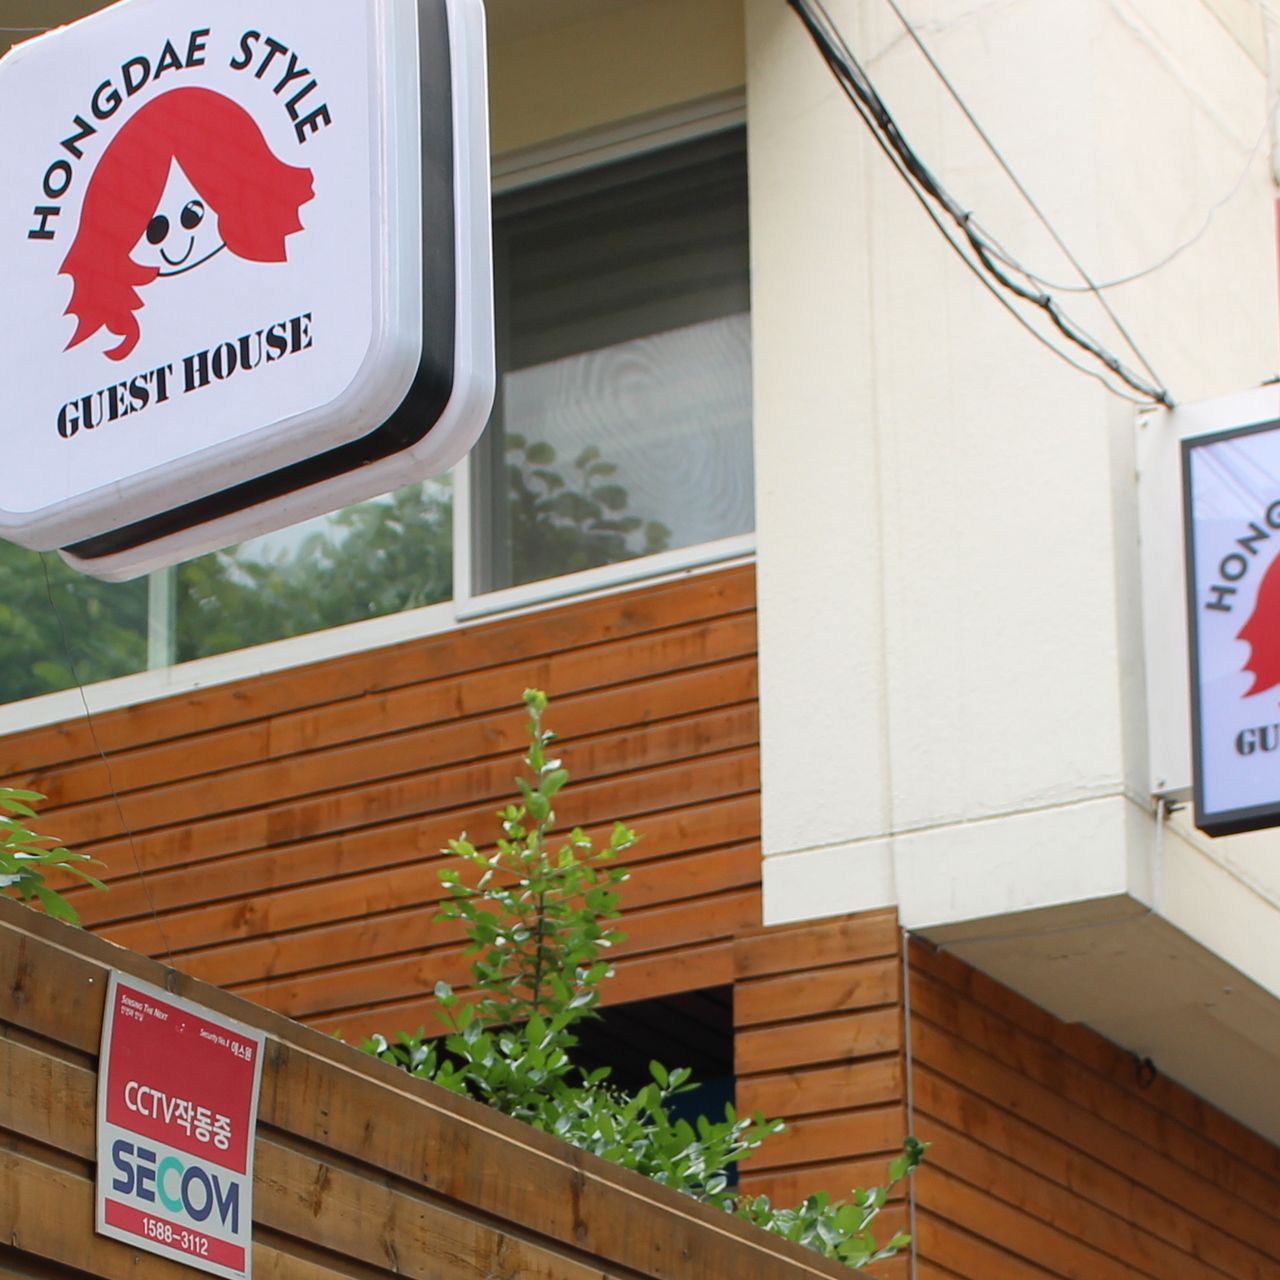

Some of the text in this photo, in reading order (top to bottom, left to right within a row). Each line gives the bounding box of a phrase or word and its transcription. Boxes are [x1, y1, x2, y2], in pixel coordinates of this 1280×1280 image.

[27, 28, 332, 240] HONGDAE STYLE
[56, 312, 313, 439] GUEST HOUSE
[231, 1041, 252, 1062] 에스원
[124, 1081, 232, 1151] CCTV작동중
[111, 1138, 240, 1235] SECOM
[142, 1217, 209, 1257] 1588-3112
